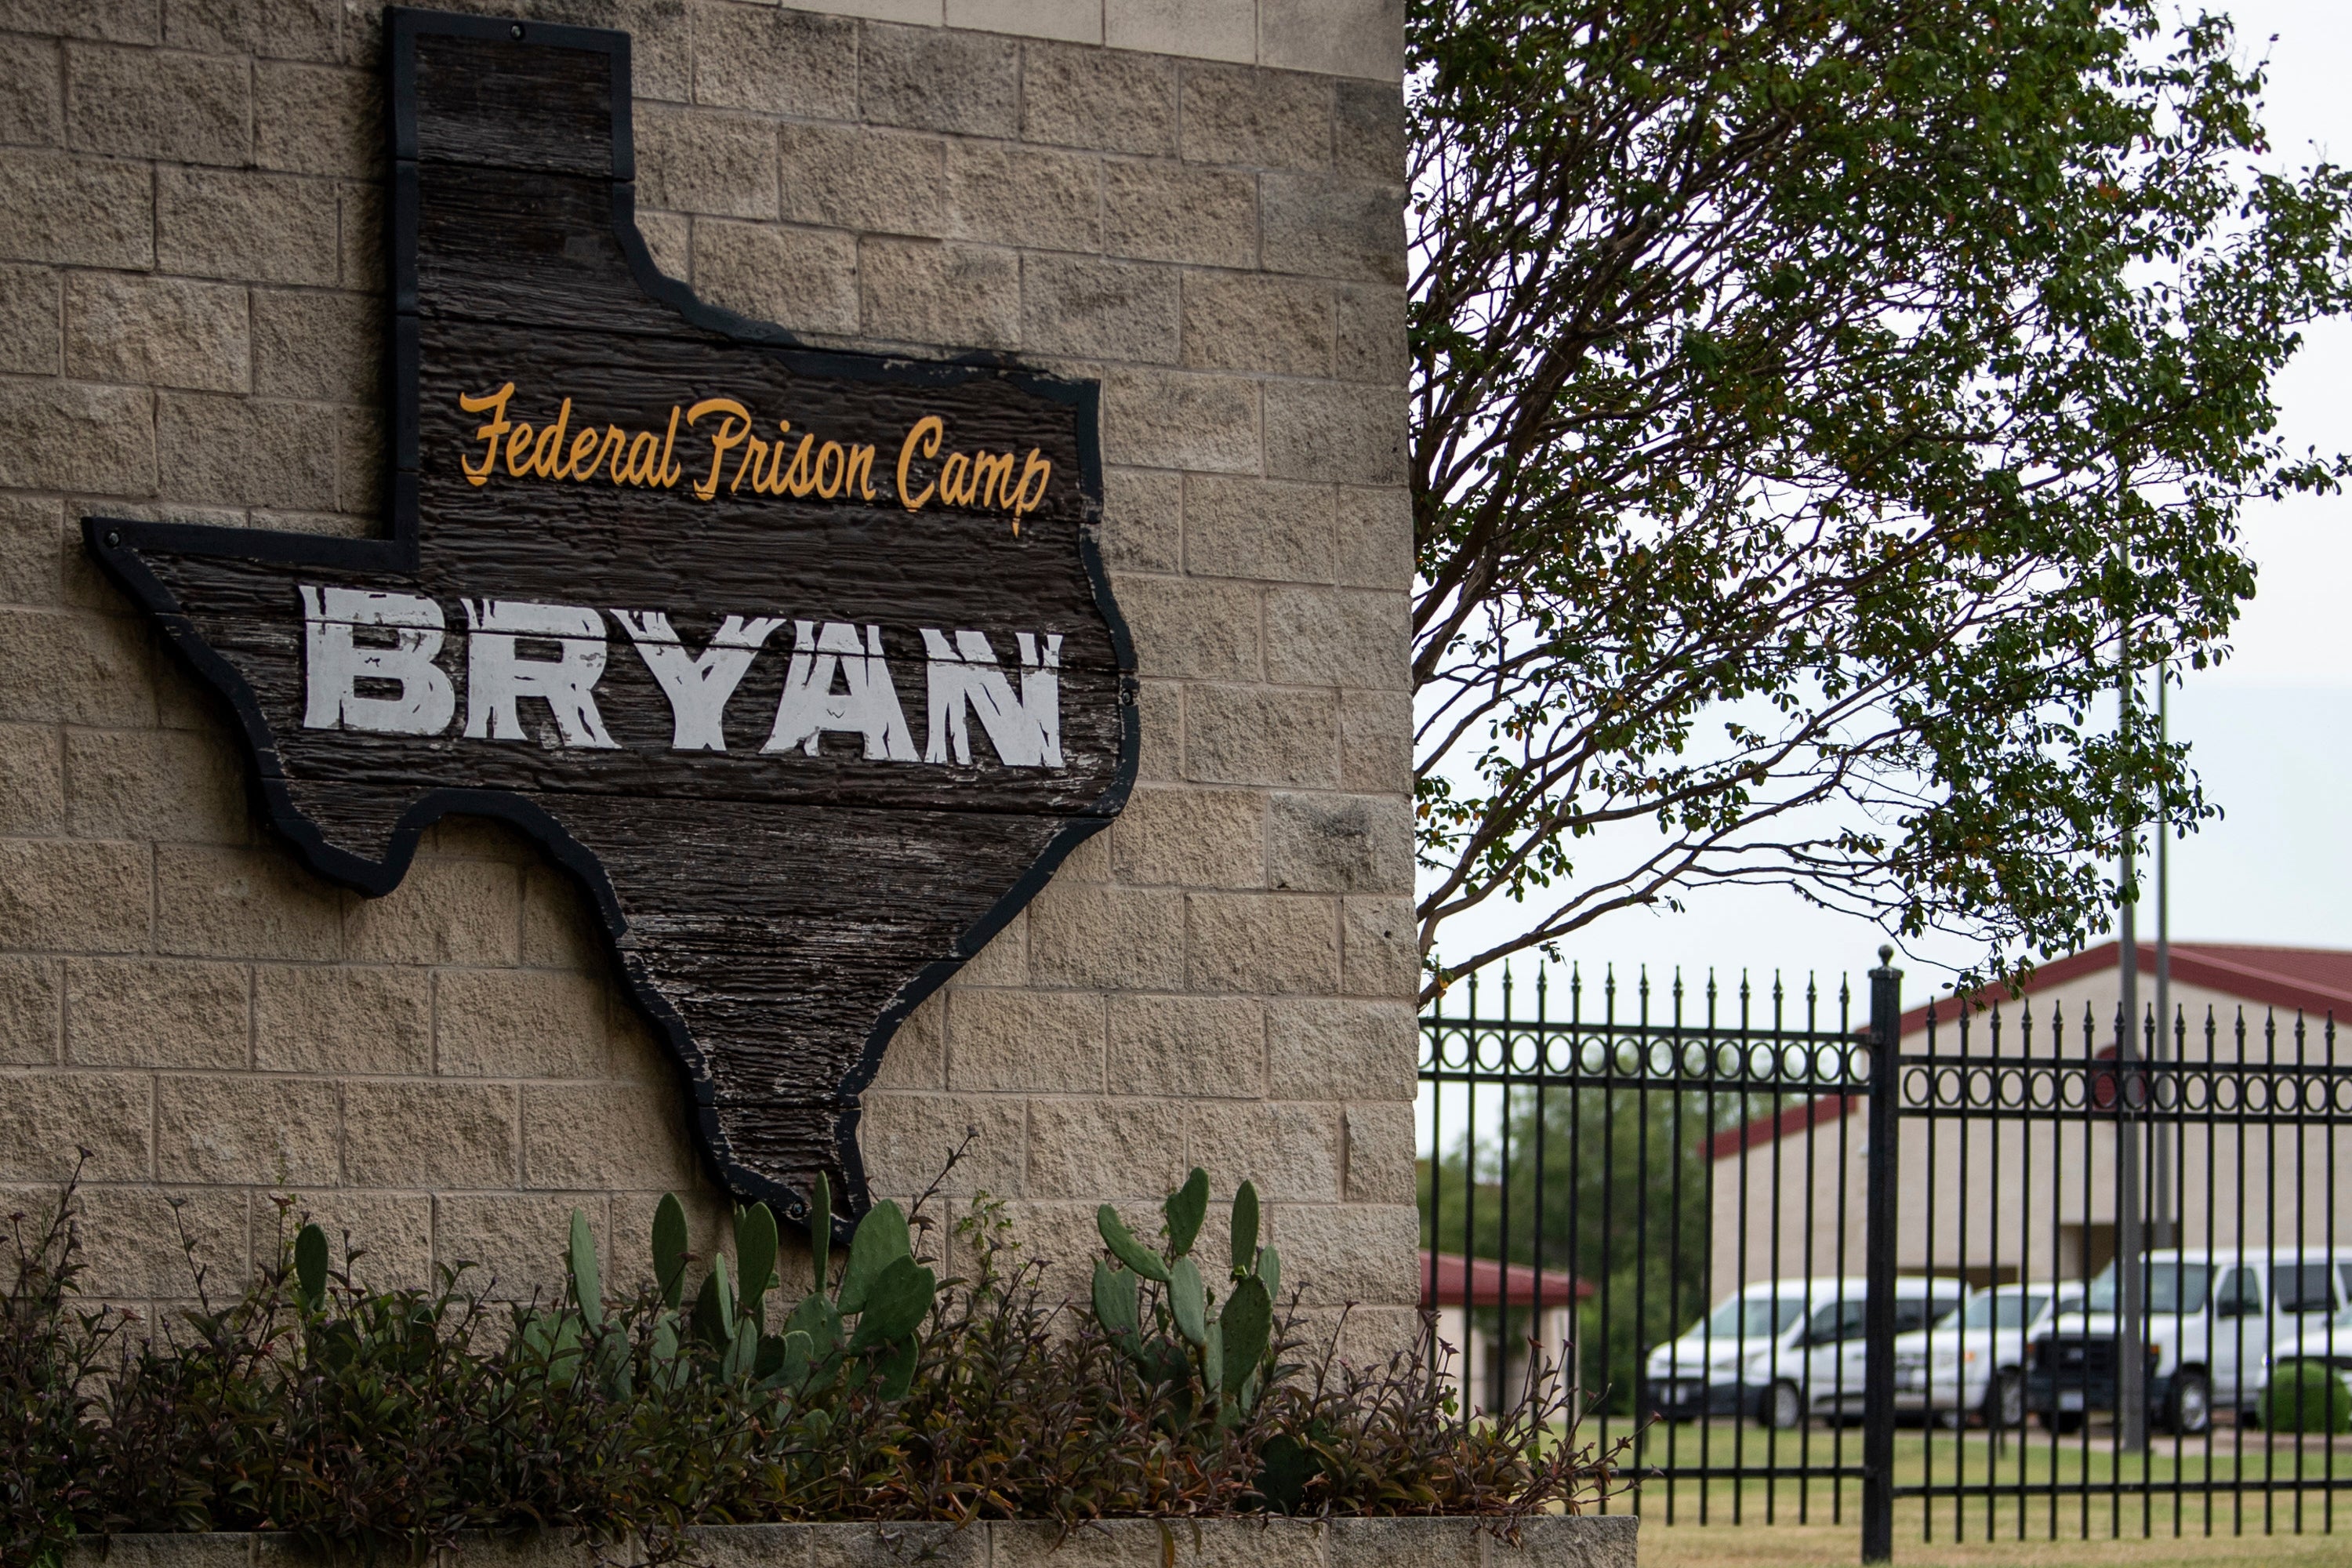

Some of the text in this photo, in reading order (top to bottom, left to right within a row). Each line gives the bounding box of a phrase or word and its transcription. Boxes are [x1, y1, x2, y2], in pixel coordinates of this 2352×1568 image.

[459, 382, 1051, 536] Federal Prison Camp
[299, 585, 1064, 768] BRYAN
